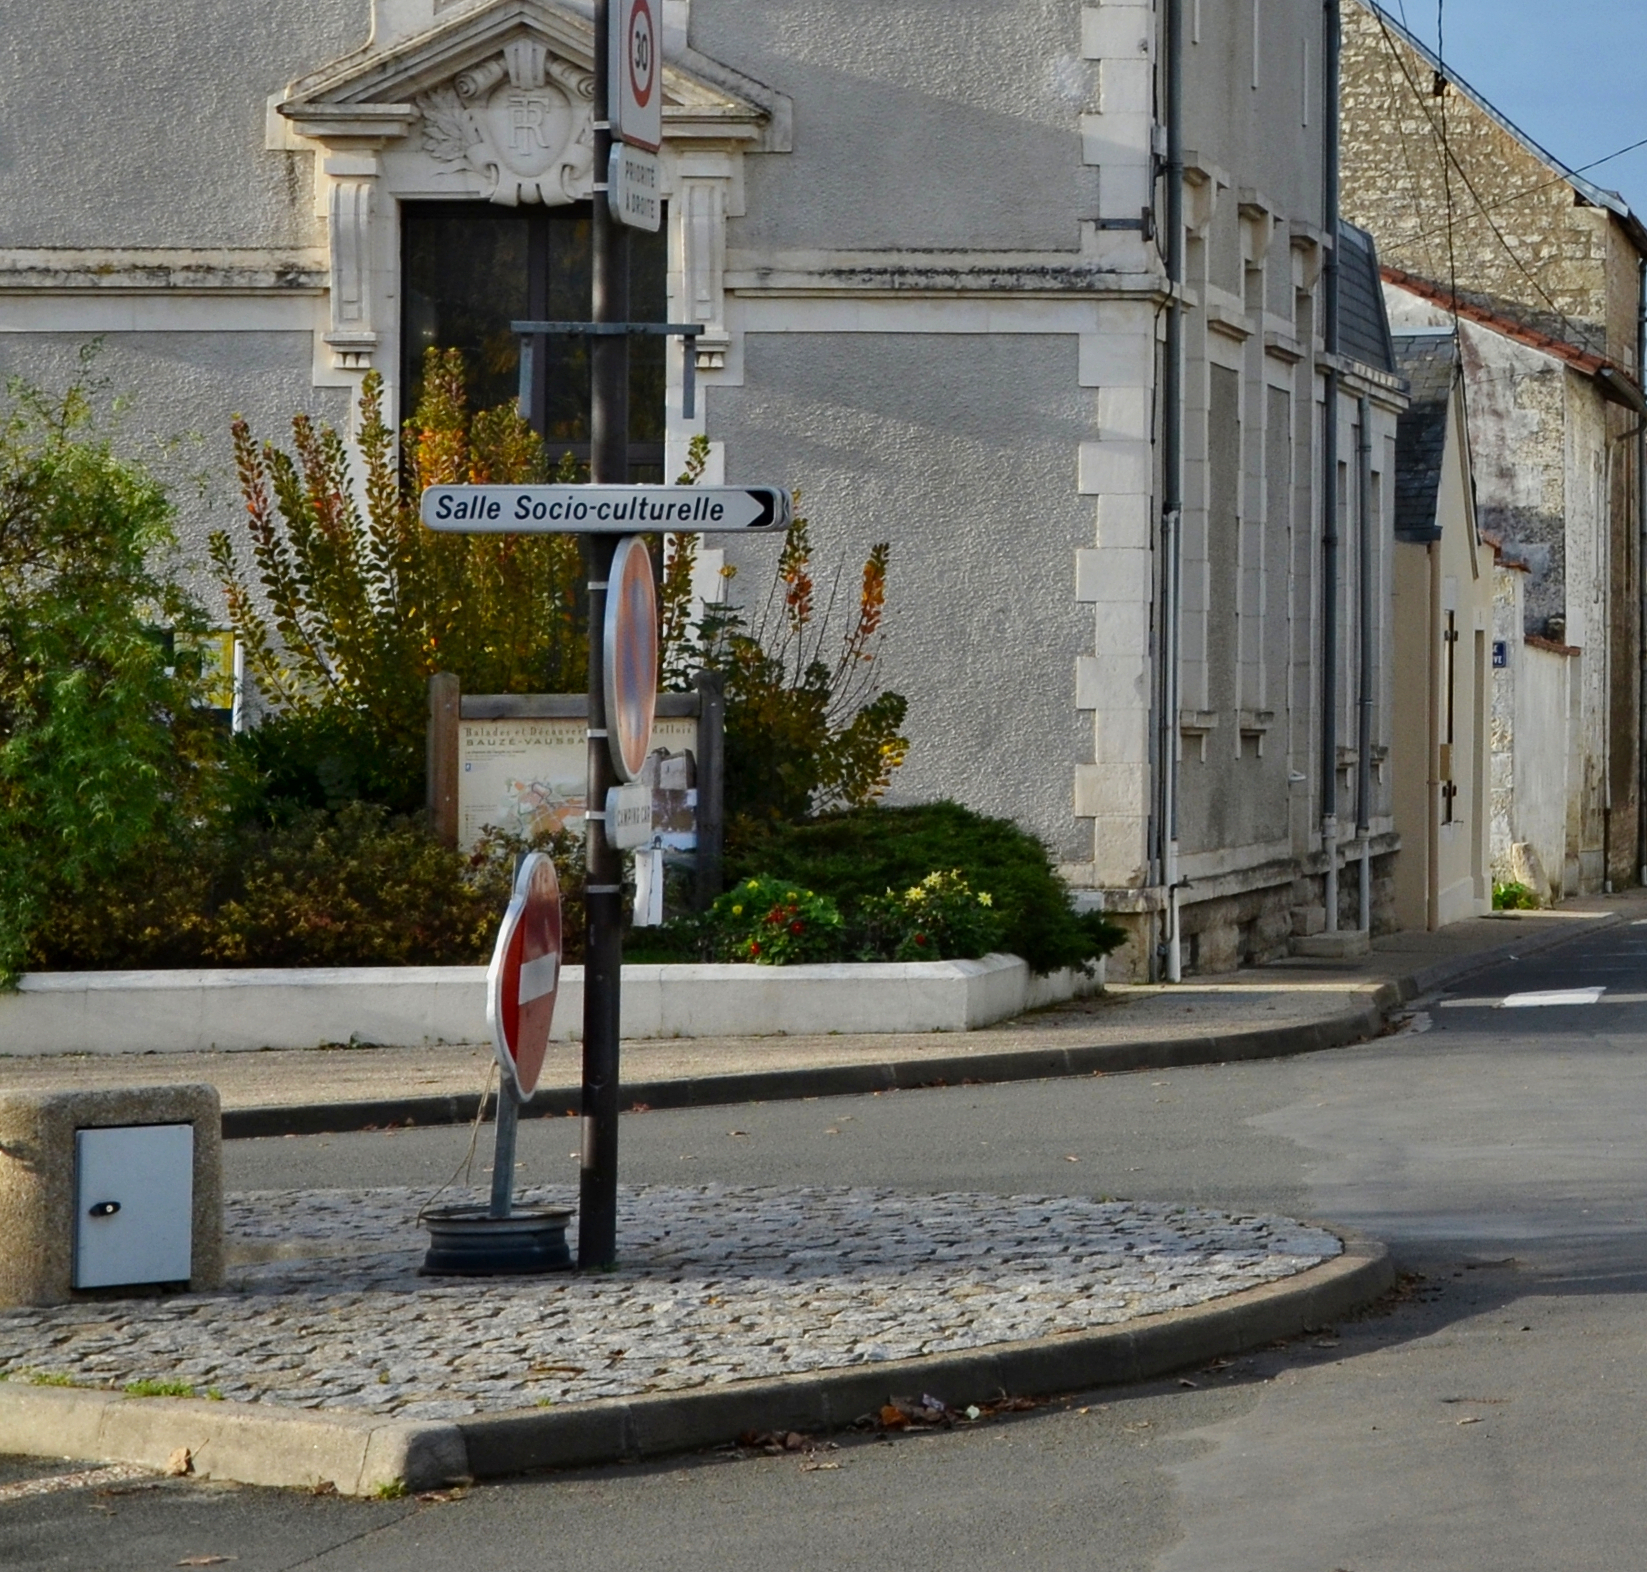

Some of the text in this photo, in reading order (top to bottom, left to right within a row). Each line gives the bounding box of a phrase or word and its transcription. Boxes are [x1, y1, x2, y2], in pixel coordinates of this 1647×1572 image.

[634, 30, 649, 71] 30
[625, 160, 655, 188] PRIORITÉ
[631, 193, 655, 219] DROITE
[435, 494, 724, 521] Salle Socio-culturelle
[466, 737, 586, 746] SAUZÉ-VAUSSA
